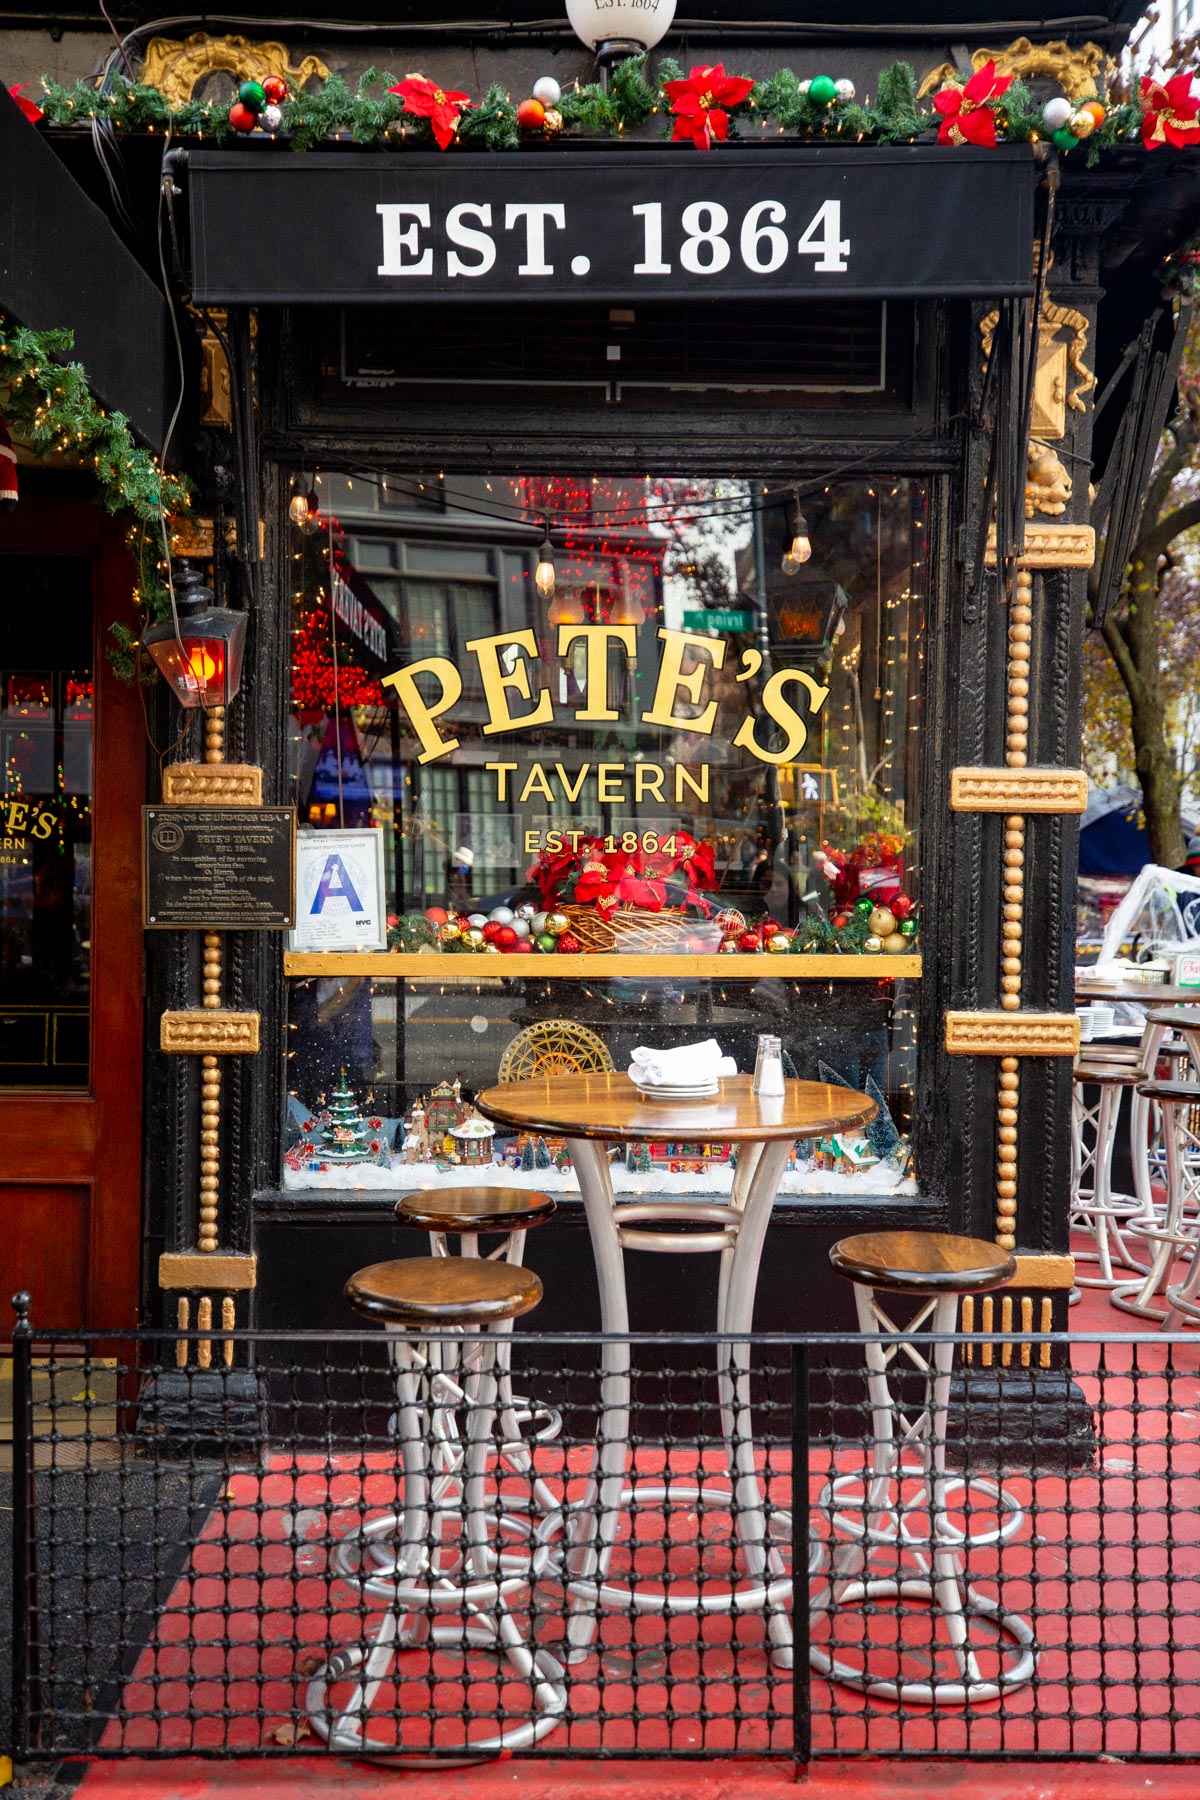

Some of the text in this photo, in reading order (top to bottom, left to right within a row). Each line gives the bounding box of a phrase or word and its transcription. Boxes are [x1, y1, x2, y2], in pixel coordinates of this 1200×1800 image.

[375, 199, 852, 277] EST. 1864
[381, 625, 829, 765] PETE'S
[484, 762, 710, 803] TAVERN
[0, 800, 58, 839] E'S
[197, 834, 275, 844] PETE'S TAVERN
[0, 837, 25, 850] RN
[524, 830, 679, 858] EST. 1864
[309, 854, 364, 915] A
